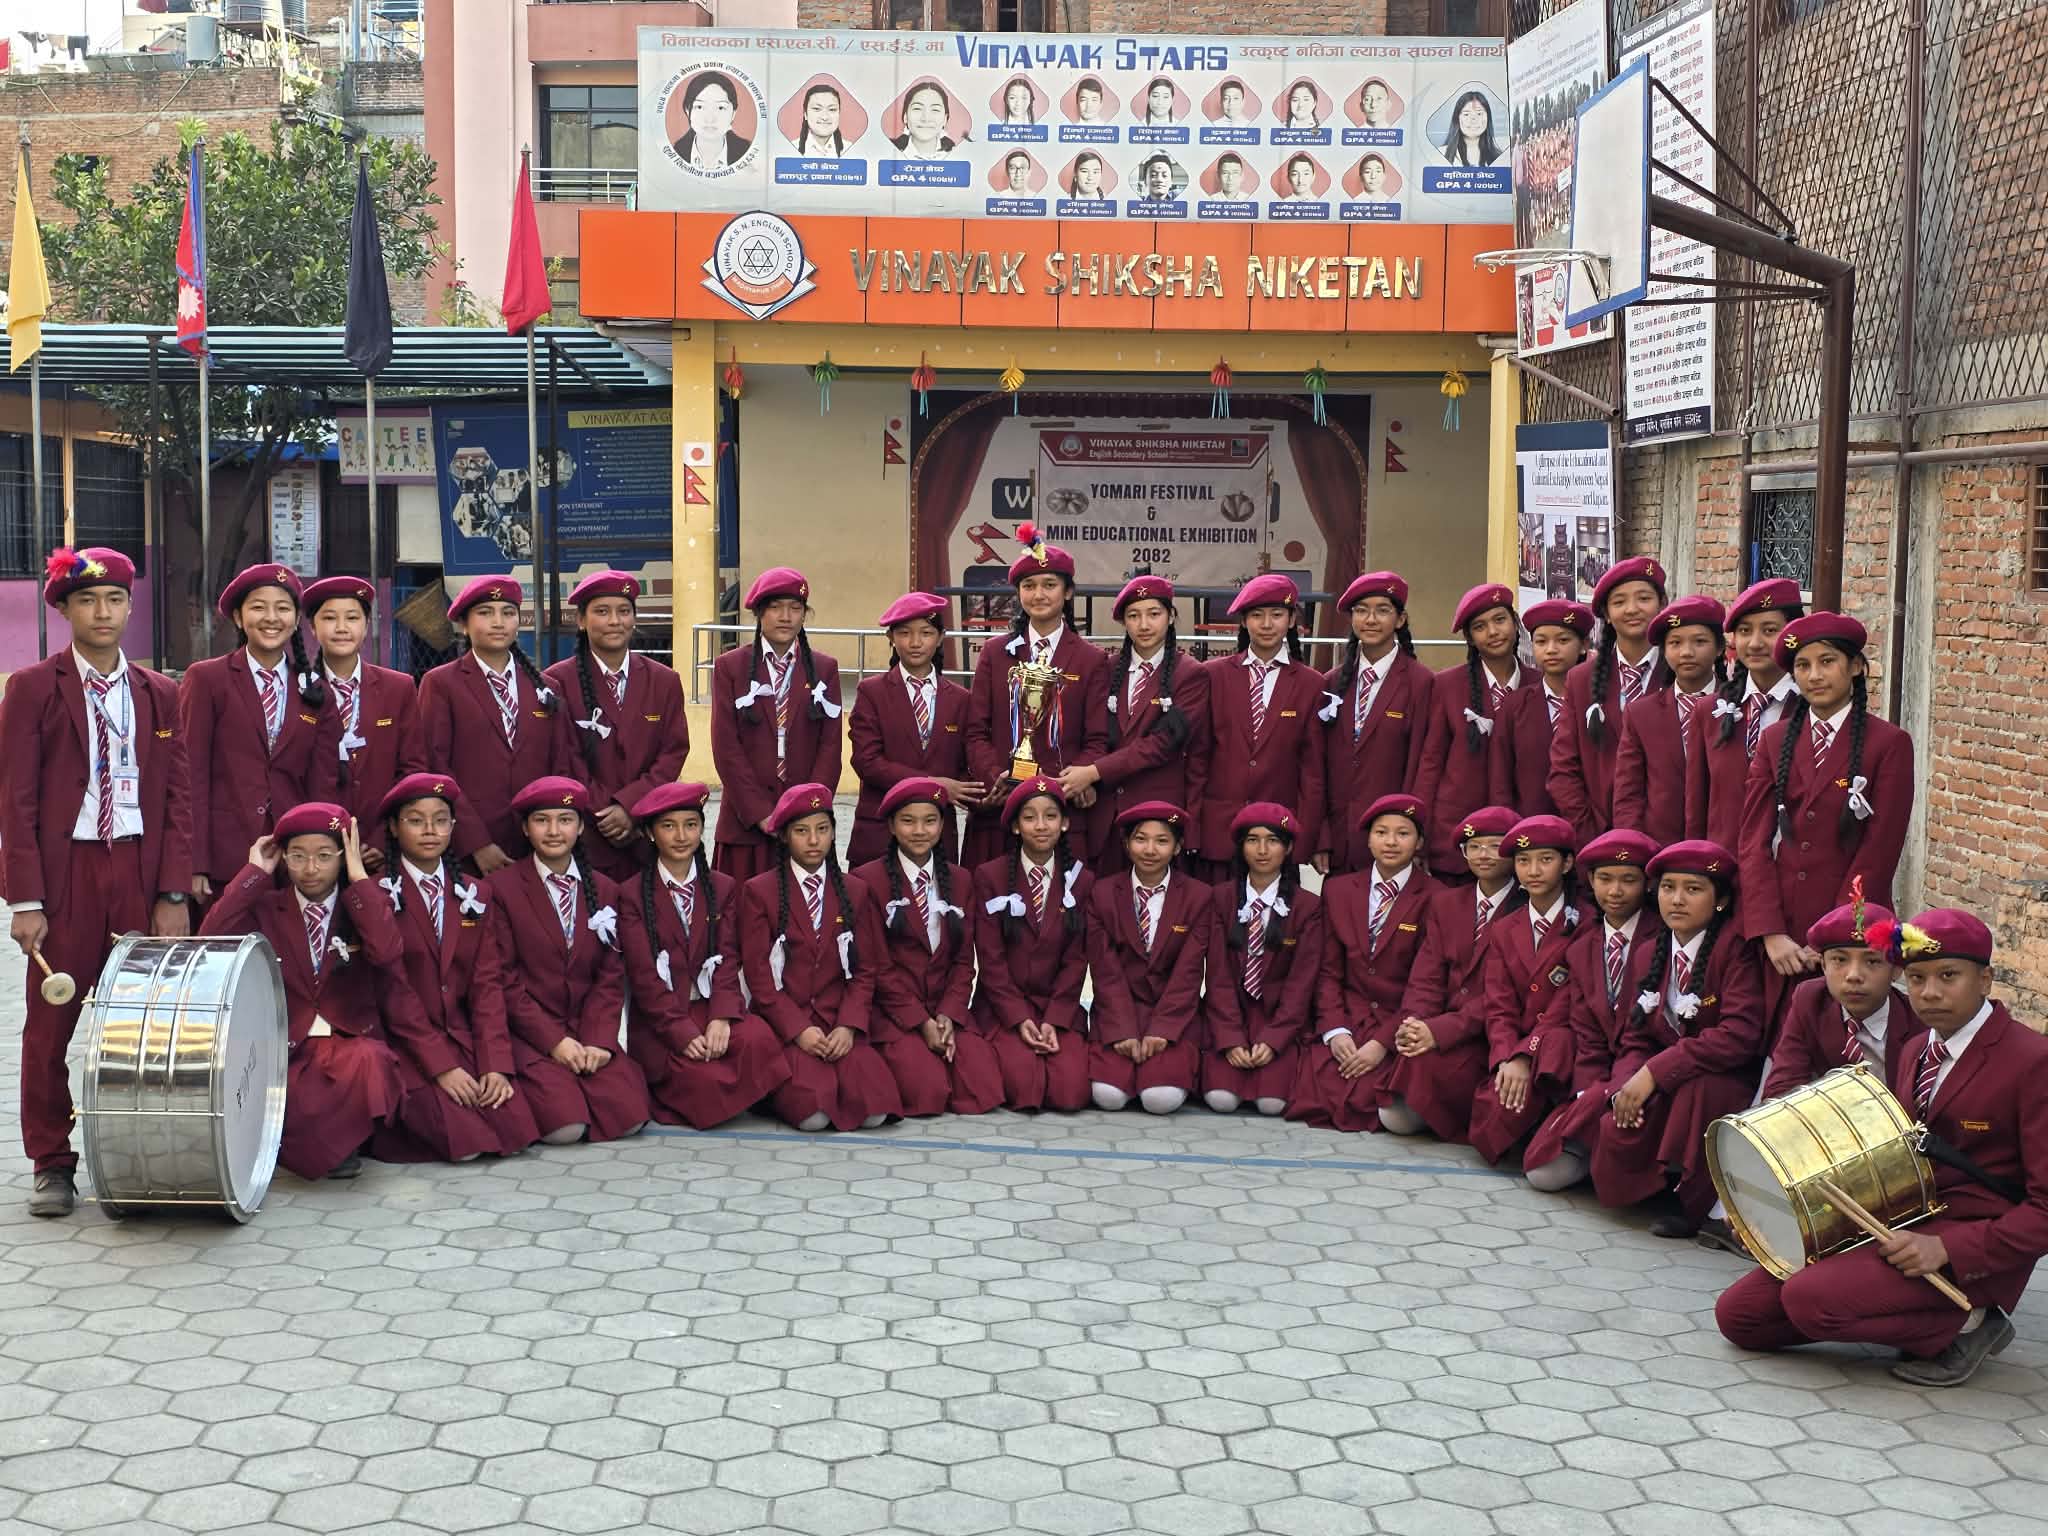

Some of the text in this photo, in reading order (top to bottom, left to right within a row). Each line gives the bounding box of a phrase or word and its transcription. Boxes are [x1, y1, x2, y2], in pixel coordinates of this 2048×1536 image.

[661, 32, 749, 48] विनायकका
[925, 41, 944, 52] मा
[1239, 46, 1289, 60] उत्कृष्ट
[1295, 43, 1345, 57] नतिजा
[1350, 46, 1401, 58] ल्याउन
[1407, 46, 1455, 58] सफल
[891, 174, 917, 184] GPA
[918, 175, 927, 183] 4
[1435, 181, 1462, 190] GPA
[1463, 181, 1472, 190] 4
[723, 235, 736, 273] VINAYAK
[751, 219, 785, 238] ENGLISH
[782, 237, 794, 273] SCHOOL
[849, 248, 1423, 299] VINAYAK SHIKSHA NIKETAN
[583, 414, 631, 425] VINAYAK
[633, 413, 647, 424] AT
[1089, 439, 1226, 450] VINAYAK SHIKSHA NIKETAN
[1089, 450, 1112, 459] English
[1113, 450, 1146, 460] Secondary
[1091, 483, 1216, 500] YOMARI FESTIVAL
[1147, 506, 1156, 521] &
[1046, 525, 1258, 544] MINI EDUCATIONAL EXHIBITION
[1132, 548, 1171, 563] 2082
